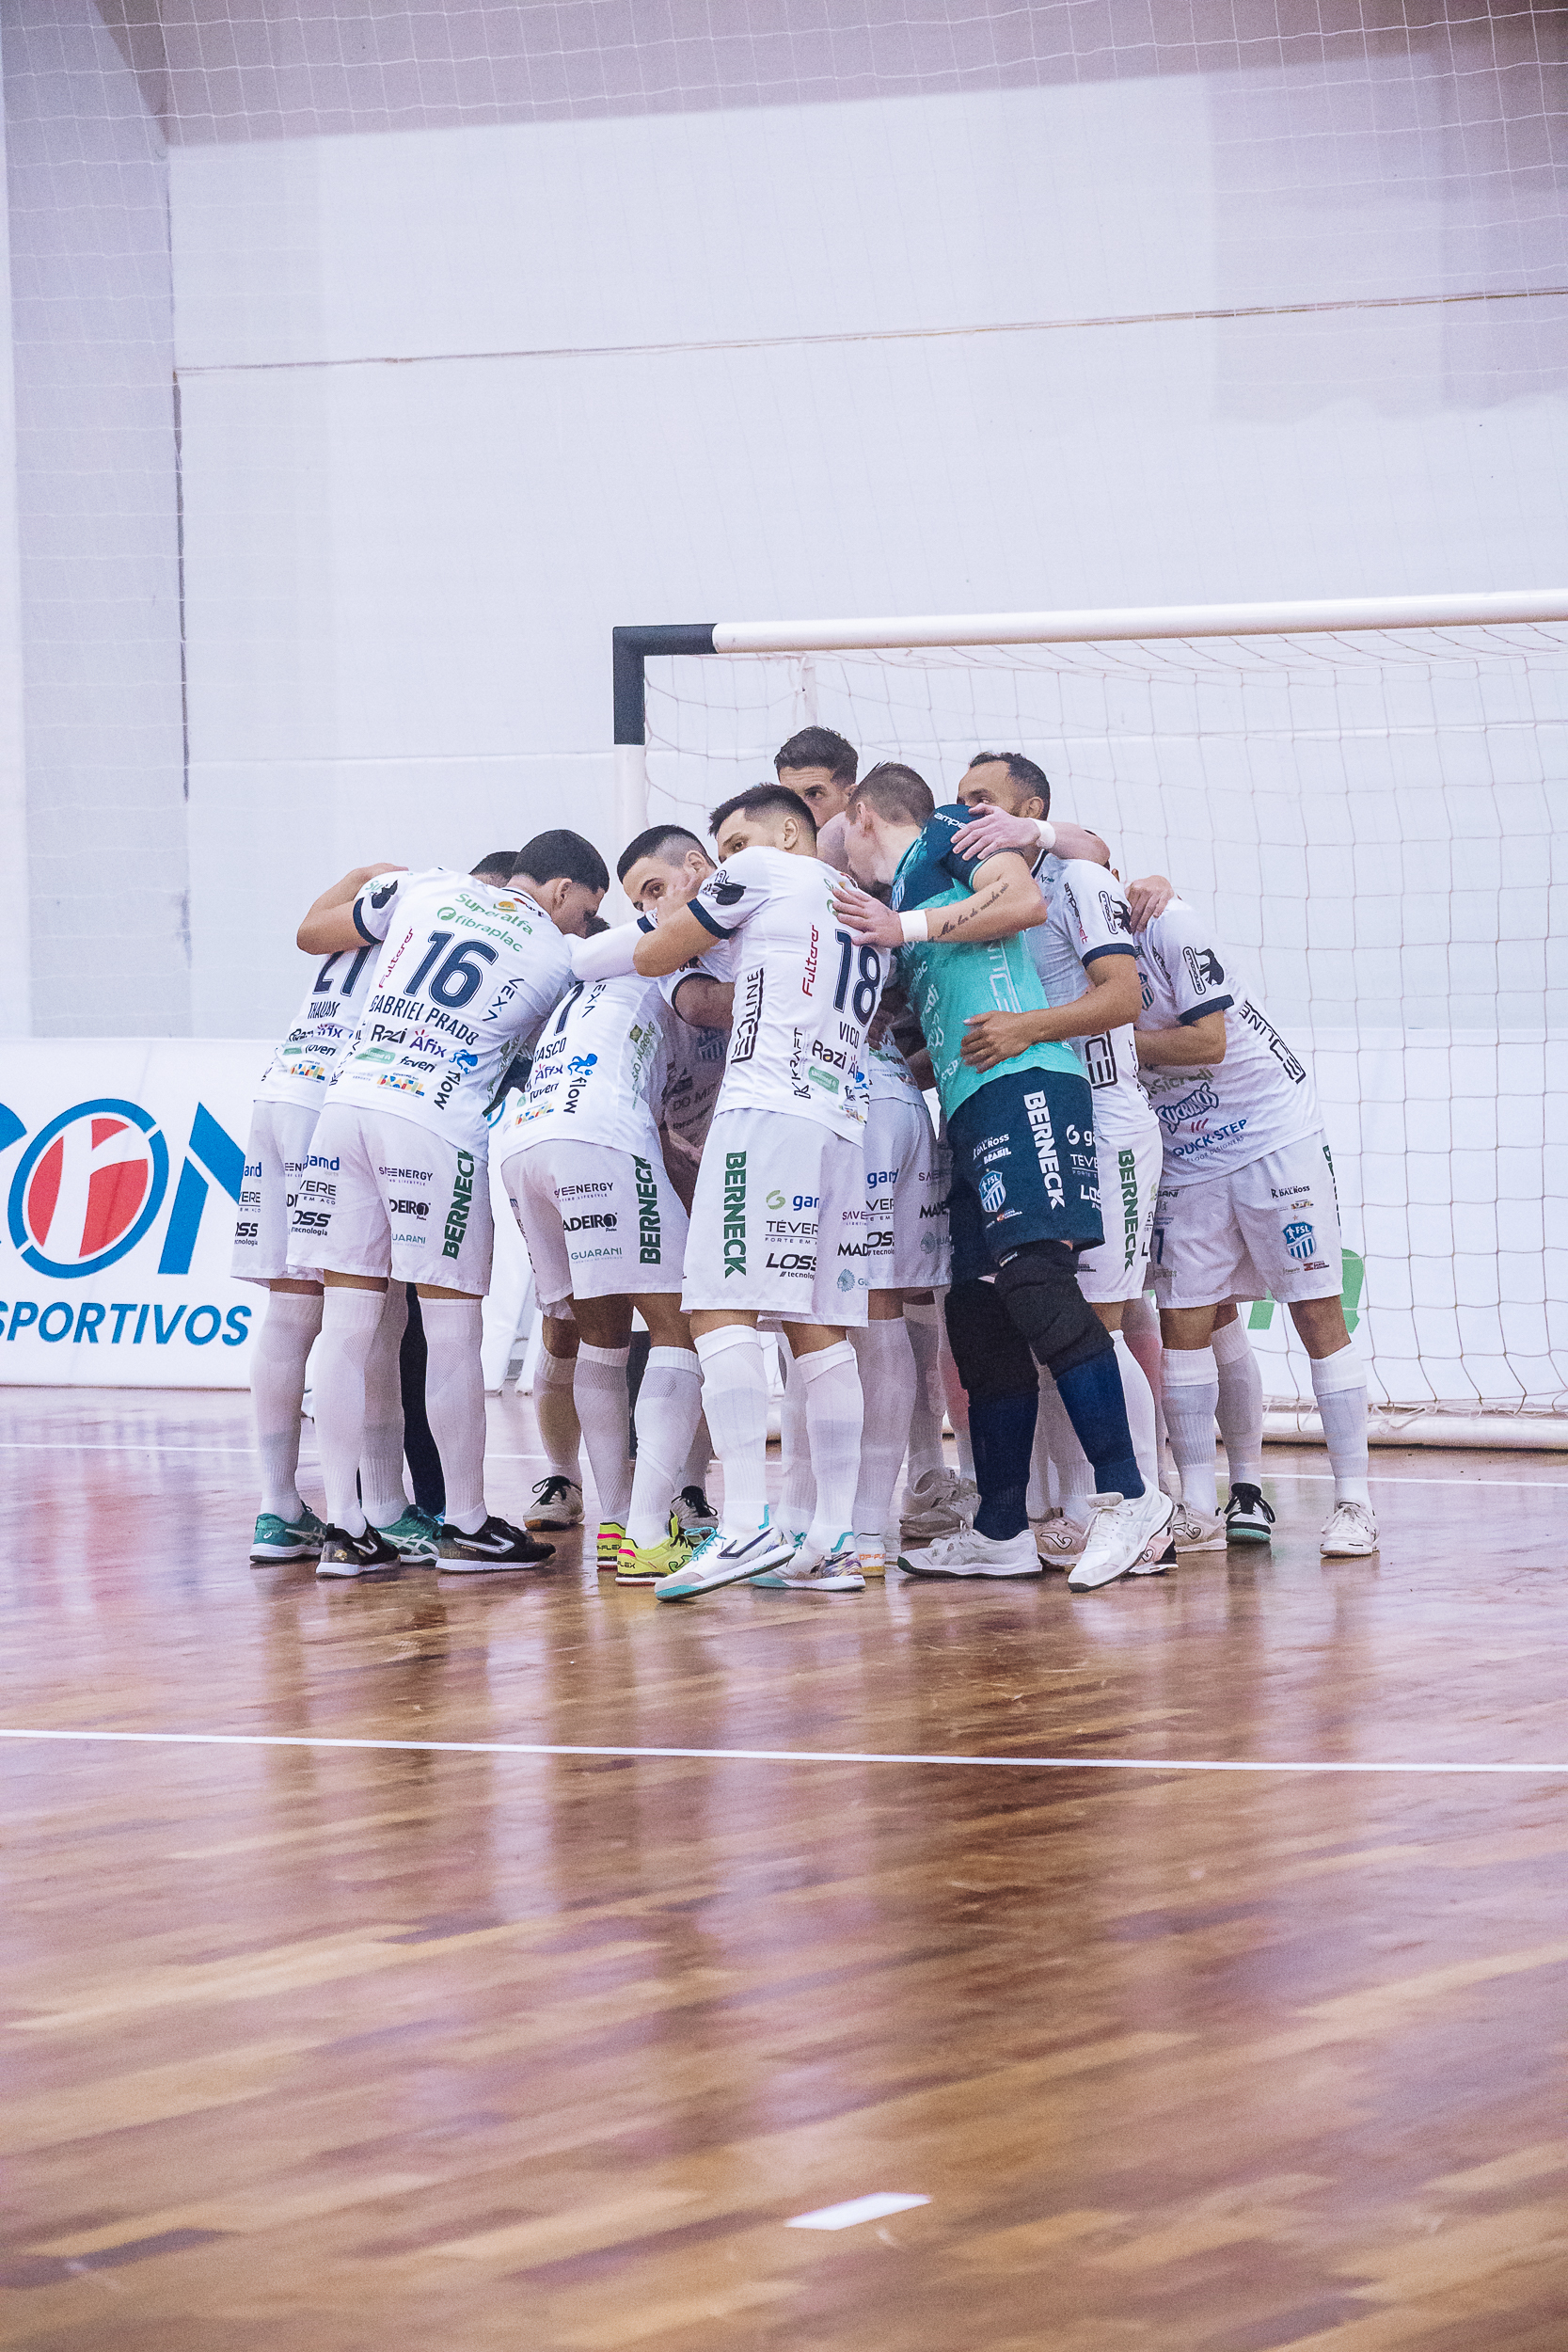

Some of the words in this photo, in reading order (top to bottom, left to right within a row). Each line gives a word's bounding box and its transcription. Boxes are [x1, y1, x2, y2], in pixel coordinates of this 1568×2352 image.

[454, 893, 533, 935] Superalfa
[455, 914, 524, 952] fibraplac
[404, 930, 499, 1009] 16
[833, 928, 881, 1027] 18
[369, 994, 425, 1022] GABRIEL
[425, 1007, 480, 1046] PRADO
[812, 1039, 847, 1070] Razi
[434, 1070, 462, 1110] flow
[562, 1076, 588, 1114] flow
[1023, 1089, 1066, 1210] BERNECK
[1070, 1152, 1099, 1169] TÉVE
[987, 1175, 1000, 1187] FSL
[293, 1209, 332, 1229] OSS
[442, 1149, 474, 1261] BERNECK
[562, 1213, 618, 1232] ADEIRO
[723, 1150, 747, 1279] BERNECK
[1117, 1148, 1138, 1272] BERNECK
[391, 1232, 427, 1245] UARANI
[765, 1219, 818, 1235] TÉVER
[765, 1236, 794, 1245] FORTE
[1295, 1224, 1310, 1234] FSL
[571, 1247, 623, 1261] GUARANI
